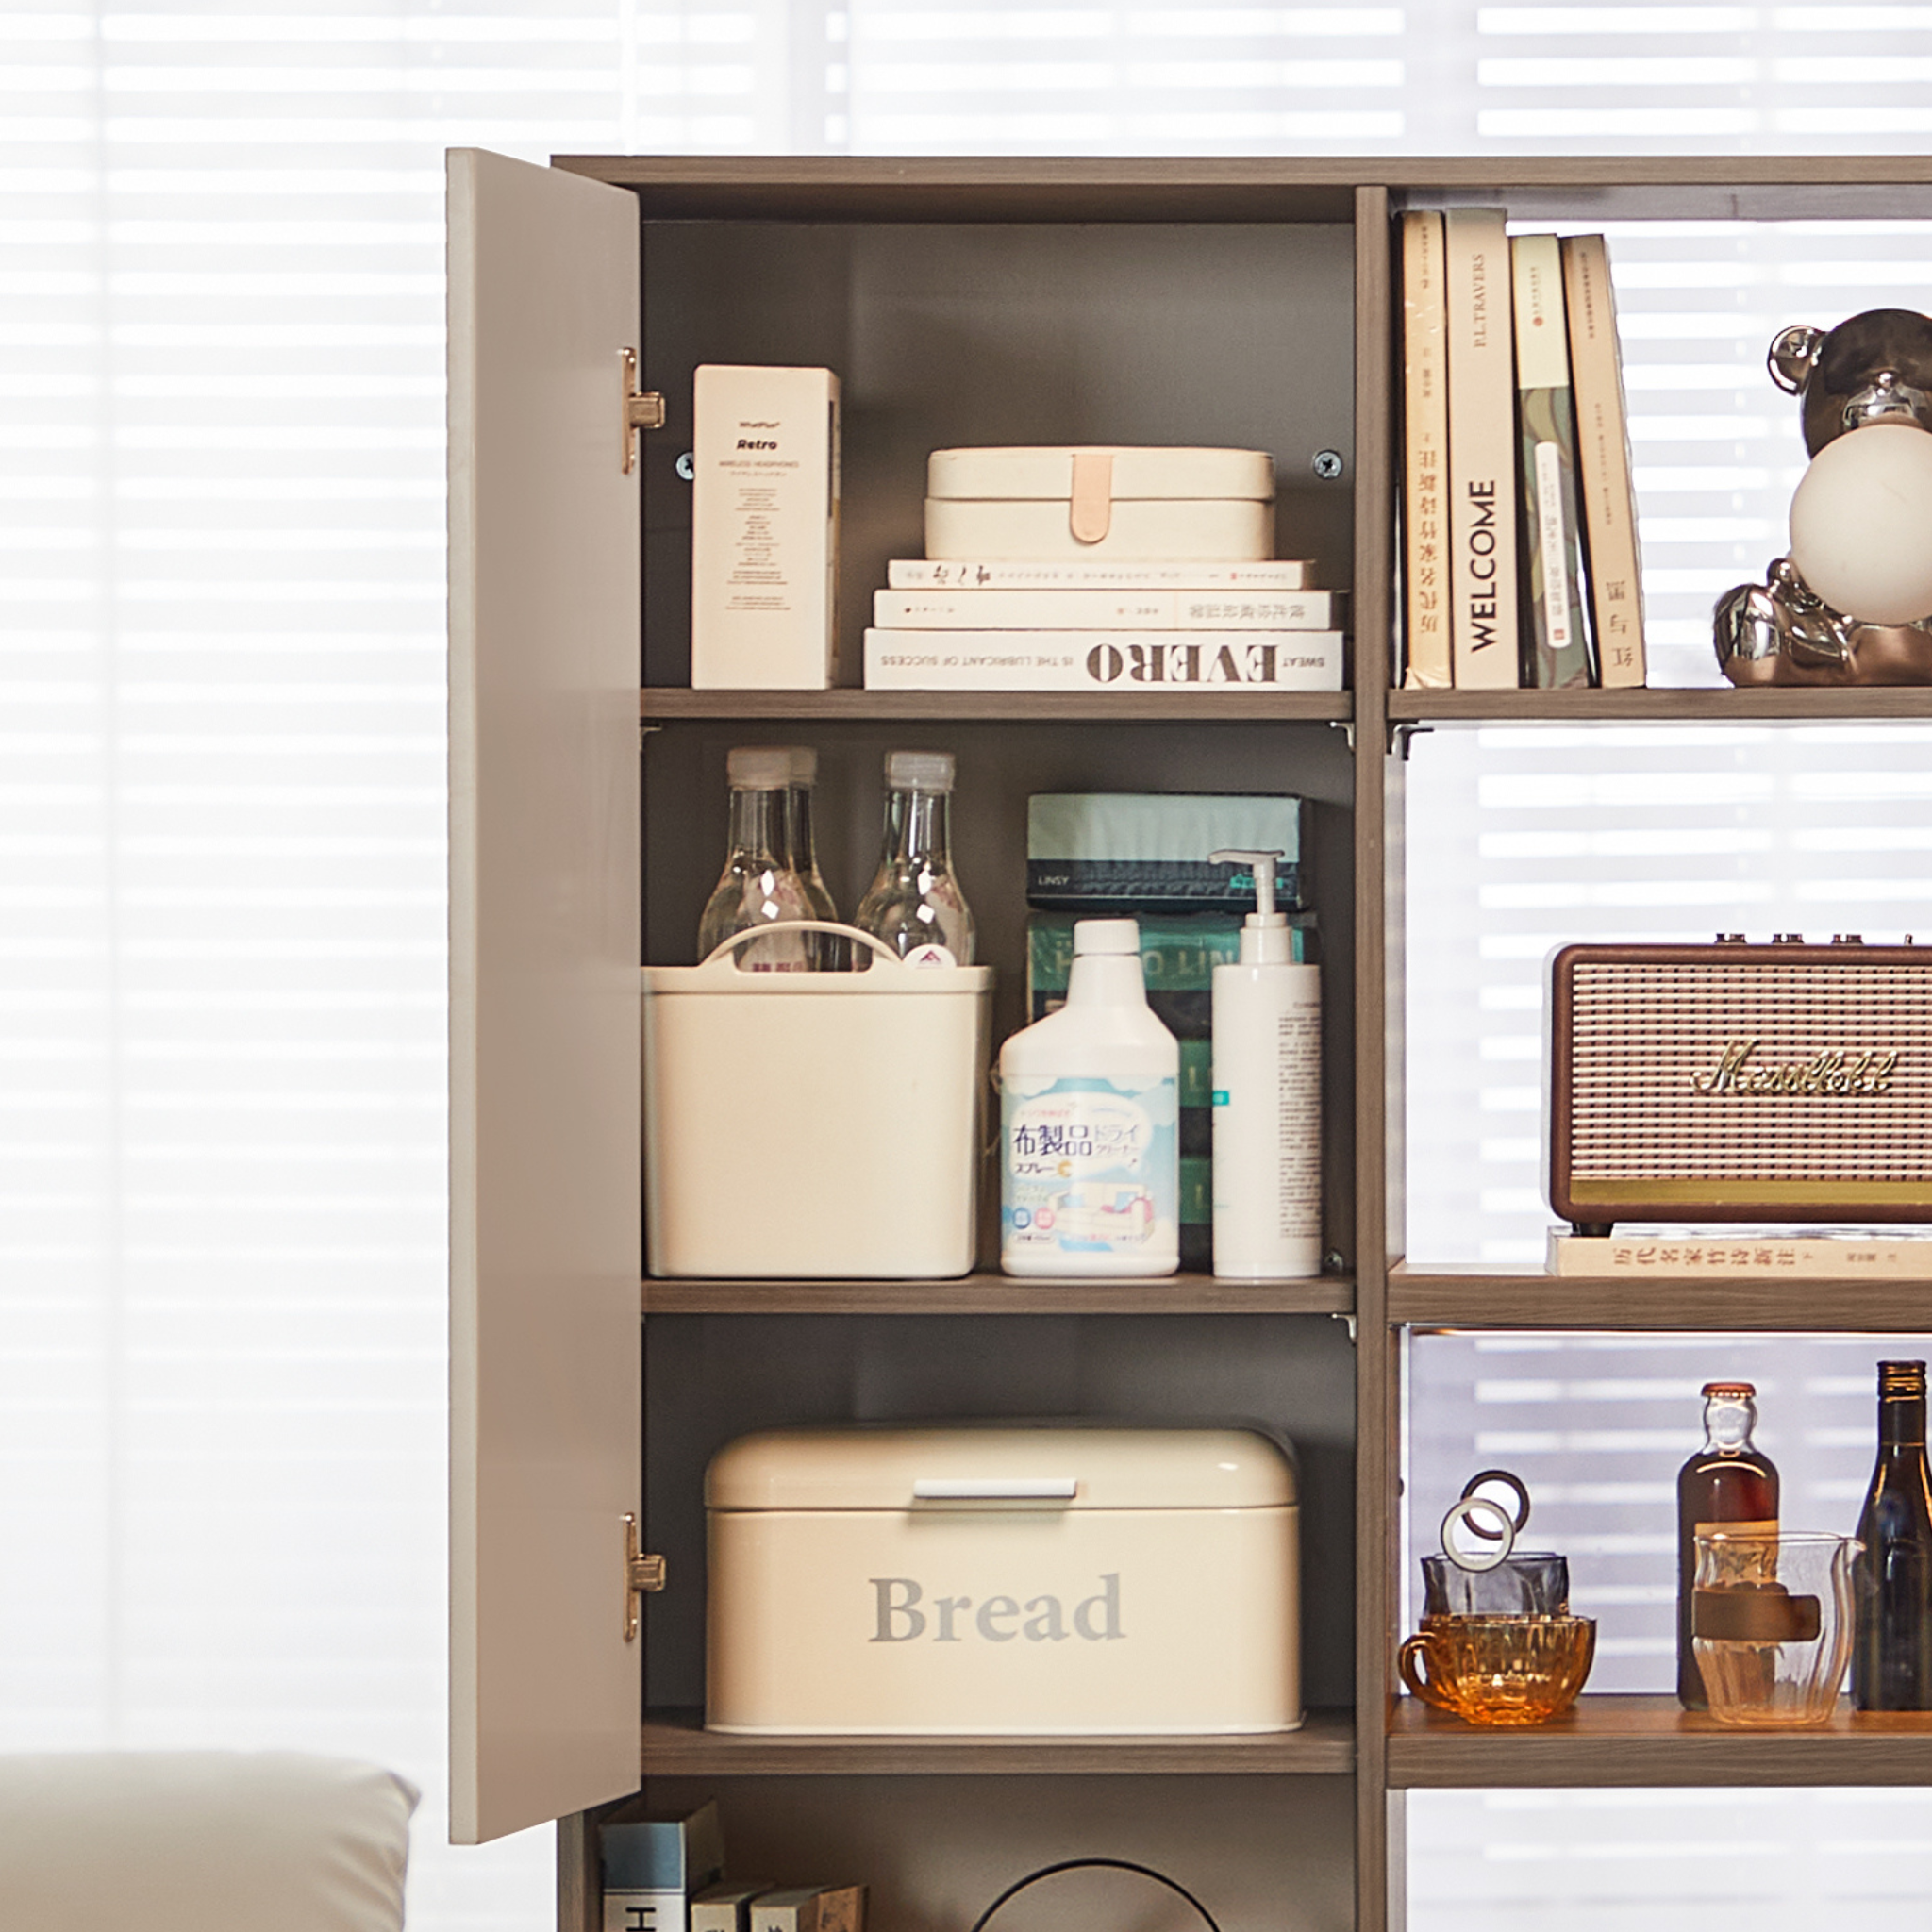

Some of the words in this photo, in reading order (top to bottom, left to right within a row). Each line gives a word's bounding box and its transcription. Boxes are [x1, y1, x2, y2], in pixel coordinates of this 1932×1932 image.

[737, 439, 778, 450] Retro
[1468, 479, 1497, 653] WELCOME
[1605, 578, 1635, 668] 红与黑
[881, 655, 939, 666] SUCCESS
[1086, 643, 1278, 683] EVERO
[1283, 657, 1325, 668] SWEAT
[1038, 875, 1070, 886] LINSY
[1013, 1124, 1092, 1156] 布製品
[867, 1573, 1127, 1643] Bread
